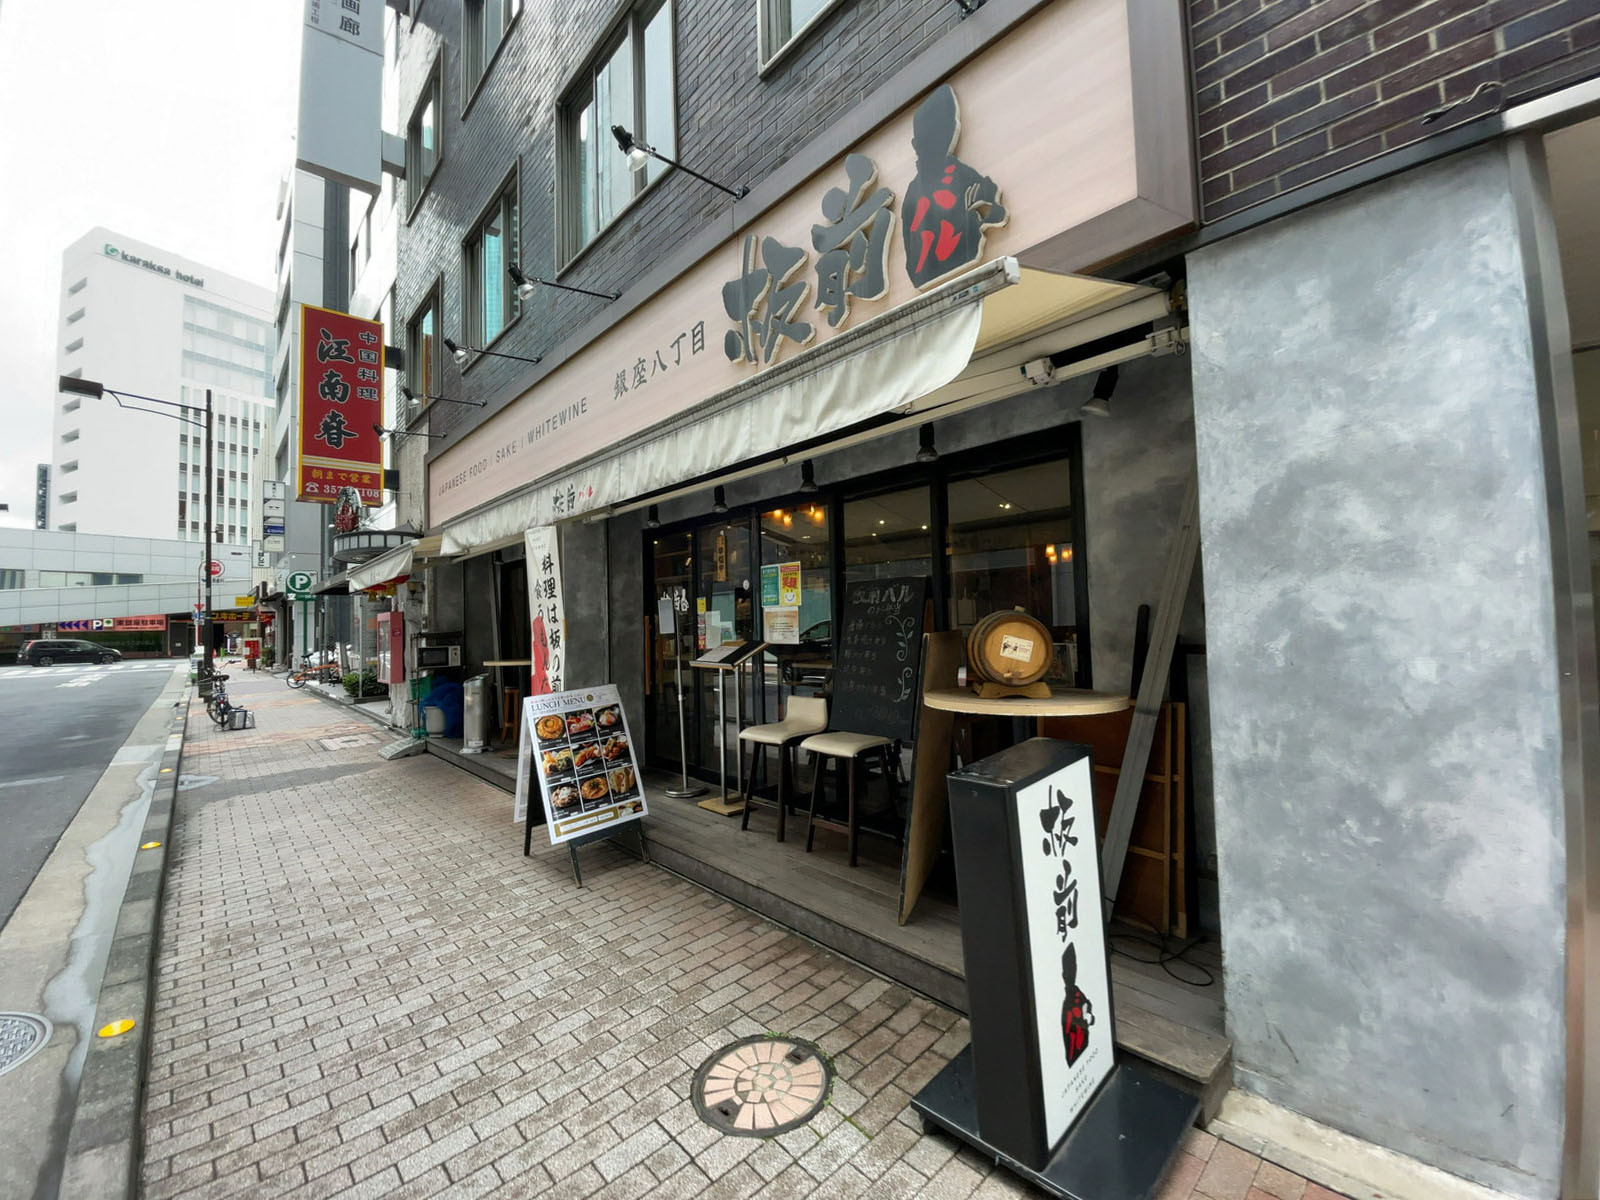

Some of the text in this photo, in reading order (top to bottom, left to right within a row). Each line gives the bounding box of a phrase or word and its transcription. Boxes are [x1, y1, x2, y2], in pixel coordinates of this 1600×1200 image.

[121, 250, 204, 288] karaksa hotel
[314, 327, 359, 450] 江南春
[357, 331, 379, 401] 中国料理
[613, 320, 705, 400] 銀座八丁目
[438, 396, 588, 497] JAPANESE FOOD SAKE WHITEWINE
[295, 574, 309, 590] P
[530, 700, 561, 712] LUNCH
[563, 695, 586, 707] MENU
